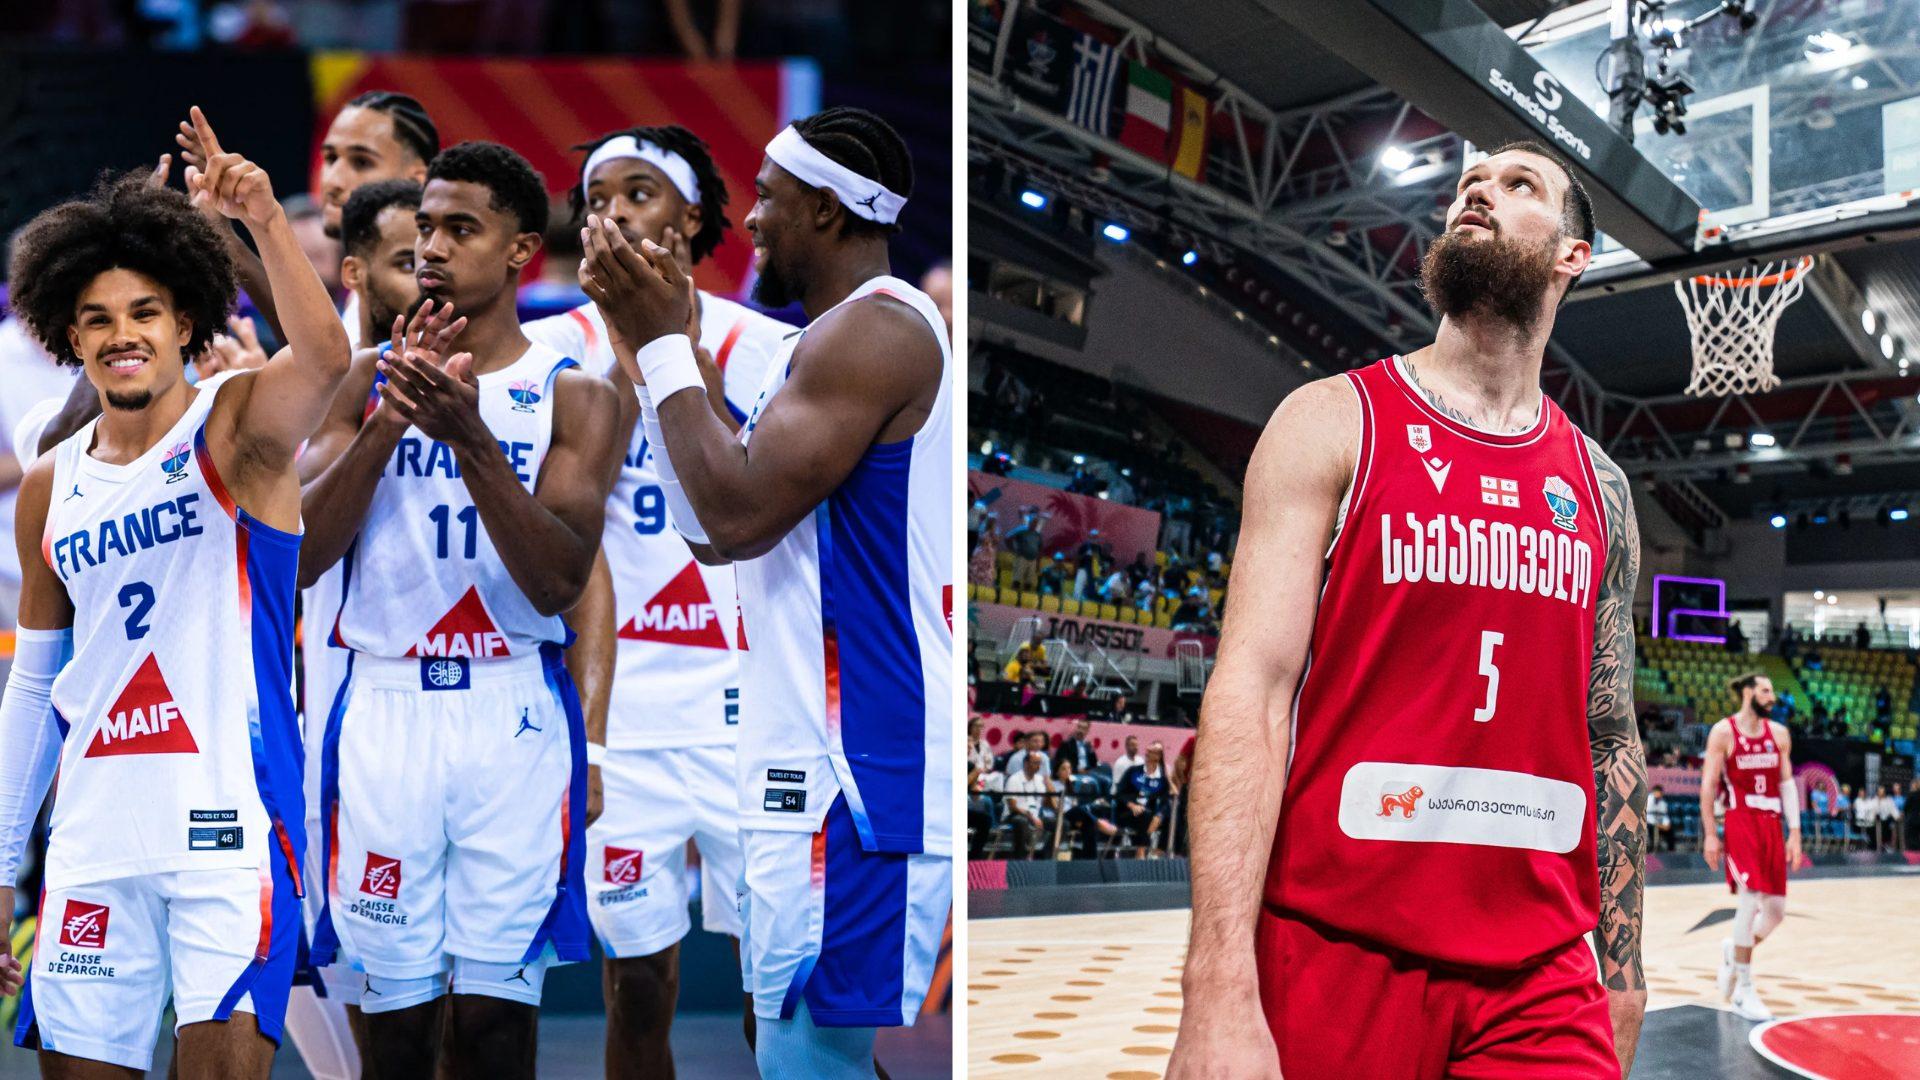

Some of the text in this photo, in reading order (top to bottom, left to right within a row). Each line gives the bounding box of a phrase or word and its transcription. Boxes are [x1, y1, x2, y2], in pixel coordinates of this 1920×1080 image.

[1488, 68, 1592, 160] Schelde Sports
[381, 437, 534, 483] RAE
[54, 492, 204, 581] FRANCE
[428, 504, 478, 560] 11
[1381, 512, 1592, 610] საქართველო
[117, 580, 156, 641] 2
[633, 604, 717, 632] MAIF
[415, 632, 504, 658] MAIF
[1473, 630, 1505, 724] 5
[100, 701, 181, 745] MAIF
[786, 796, 796, 806] 54
[1427, 798, 1532, 818] საქართველოს
[221, 834, 234, 843] 46
[350, 903, 408, 925] D'EPARGNE
[359, 898, 395, 913] CAISSE
[48, 961, 115, 978] D'EPARGNE
[60, 951, 102, 965] CAISSE
